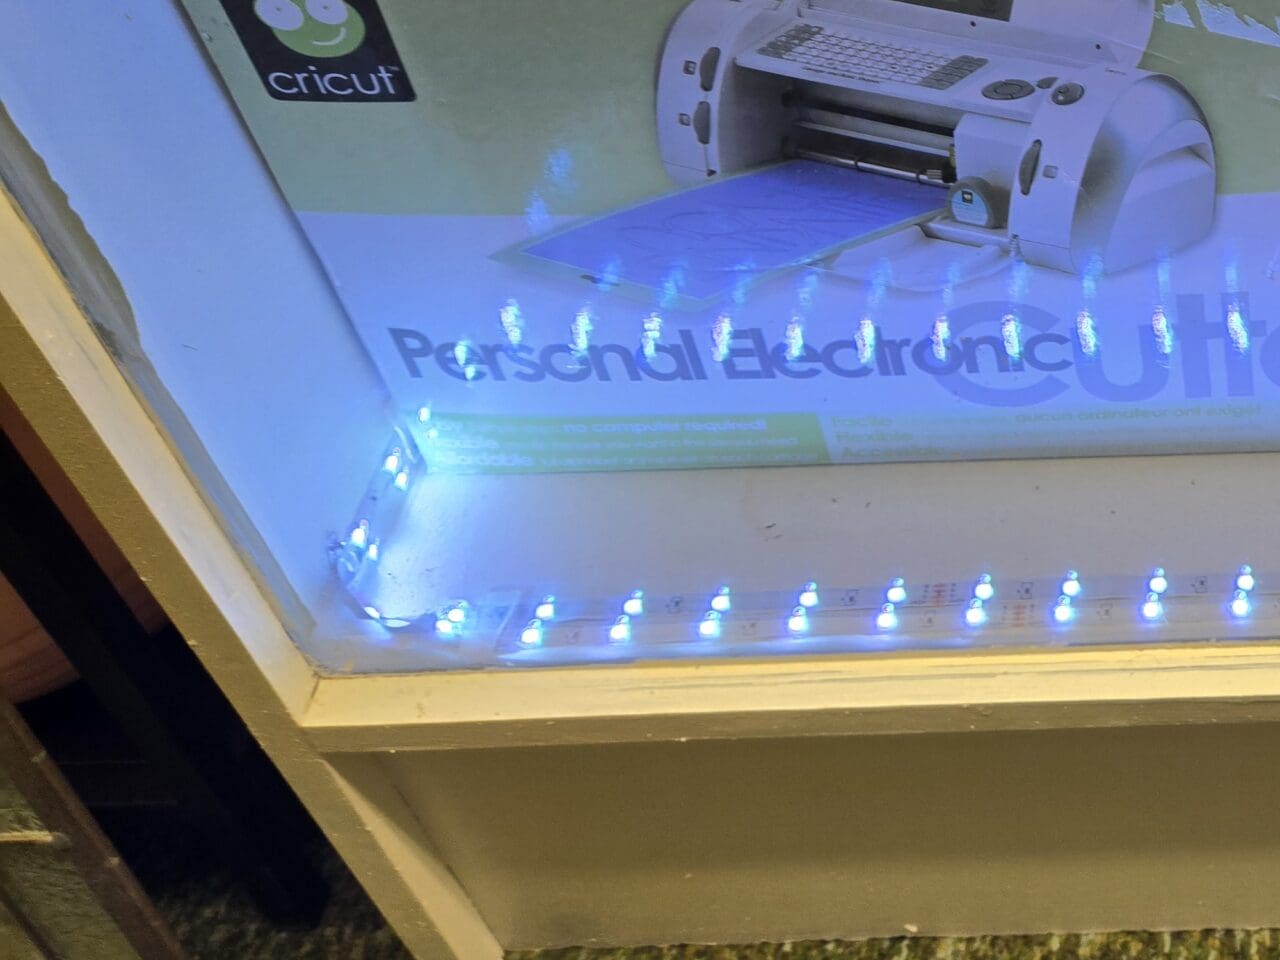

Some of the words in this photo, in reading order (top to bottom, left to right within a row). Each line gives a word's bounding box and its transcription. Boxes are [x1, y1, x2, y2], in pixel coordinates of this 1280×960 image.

[267, 65, 396, 95] cricut
[387, 326, 706, 382] Personal
[721, 326, 1075, 381] Electronic
